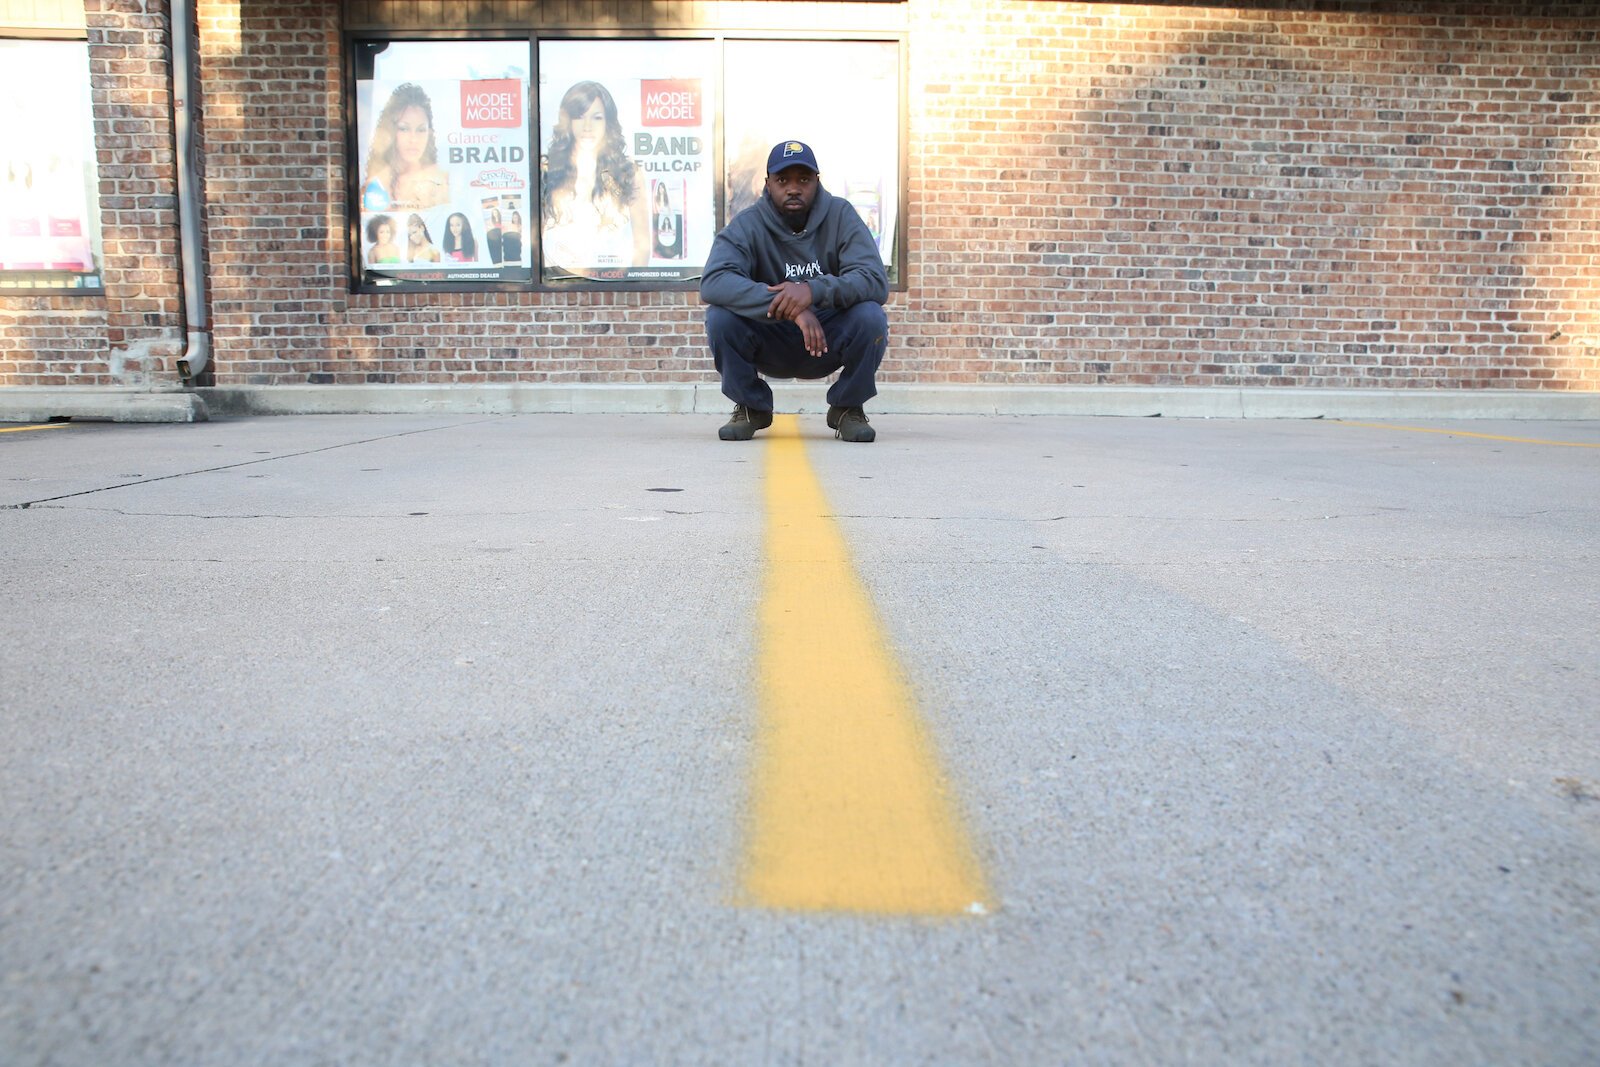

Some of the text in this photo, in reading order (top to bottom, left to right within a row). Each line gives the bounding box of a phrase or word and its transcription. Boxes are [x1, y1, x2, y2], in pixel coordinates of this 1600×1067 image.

[466, 93, 514, 106] MODEL
[646, 92, 695, 105] MODEL
[466, 107, 515, 120] MODEL
[646, 106, 695, 119] MODEL
[447, 131, 498, 145] Glance
[634, 132, 703, 156] BAND
[448, 146, 525, 164] BRAID
[671, 159, 702, 173] CAP
